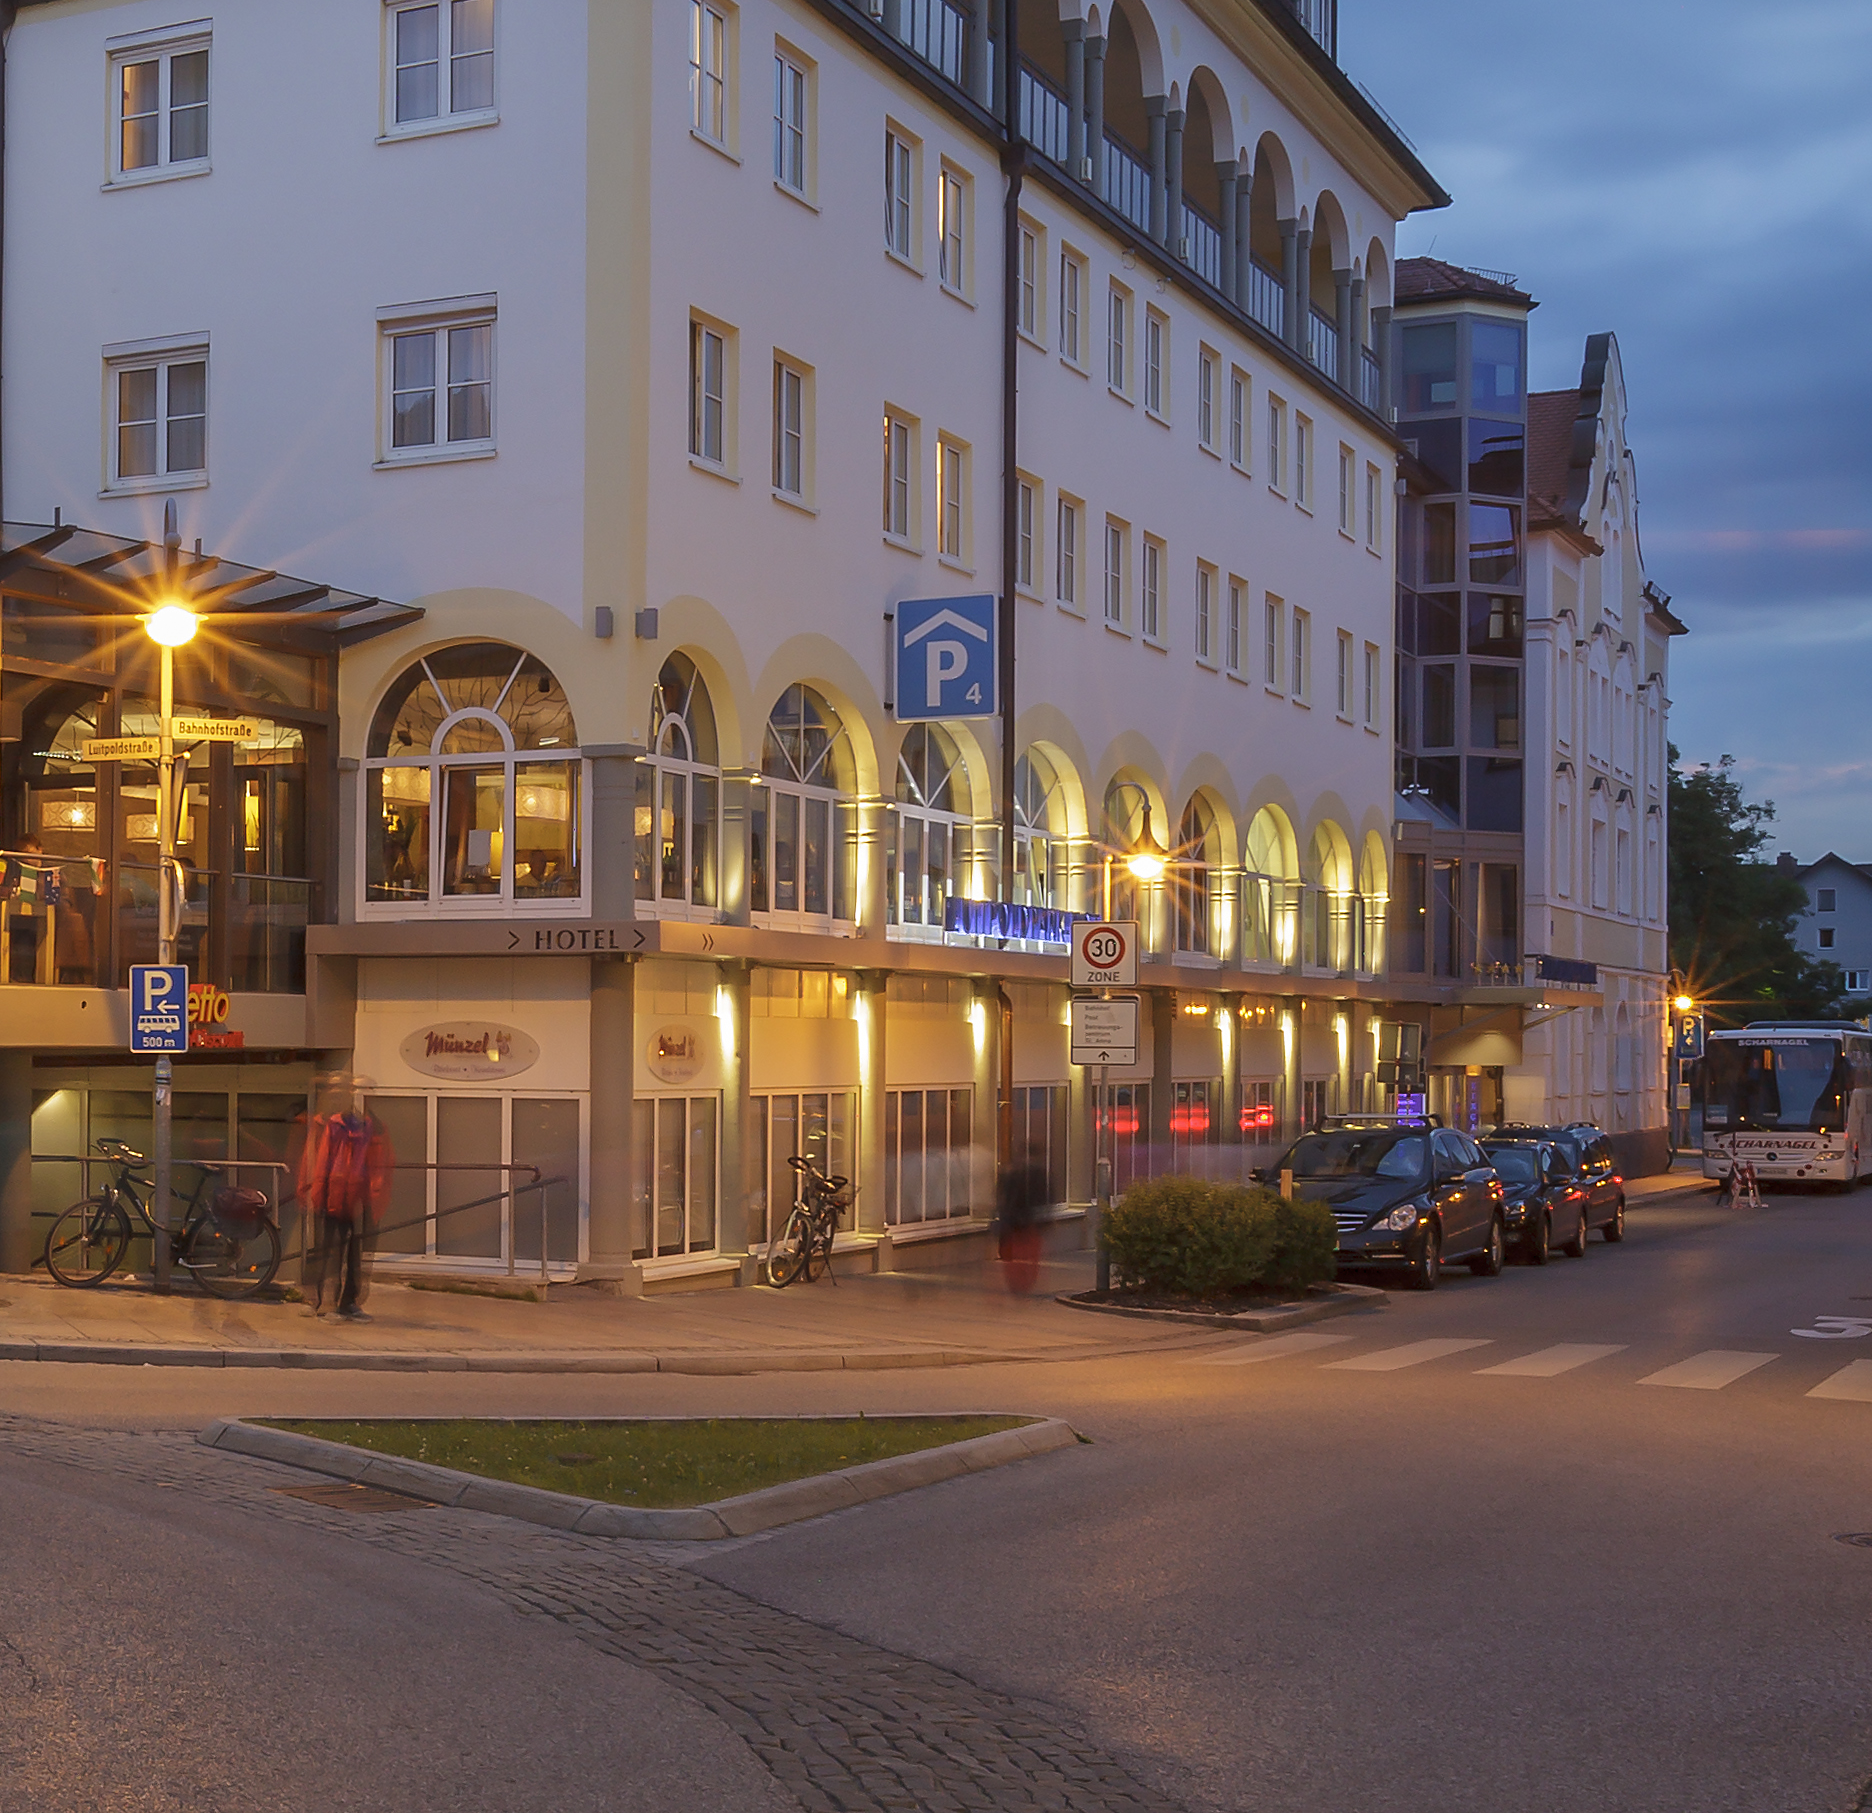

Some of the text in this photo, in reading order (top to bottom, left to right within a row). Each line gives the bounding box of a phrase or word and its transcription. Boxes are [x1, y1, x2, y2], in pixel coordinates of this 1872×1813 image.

[926, 640, 982, 707] P 4
[179, 721, 252, 737] Bahnhofstraße
[88, 740, 153, 756] Luitpoldstraße
[535, 929, 619, 950] HOTEL
[1091, 938, 1117, 958] 30
[1087, 971, 1121, 983] ZONE
[144, 970, 173, 1011] P
[188, 985, 230, 1023] etto
[142, 1037, 163, 1047] 500
[424, 1031, 489, 1057] Münzel
[1738, 1039, 1809, 1047] SCHARNAGEL
